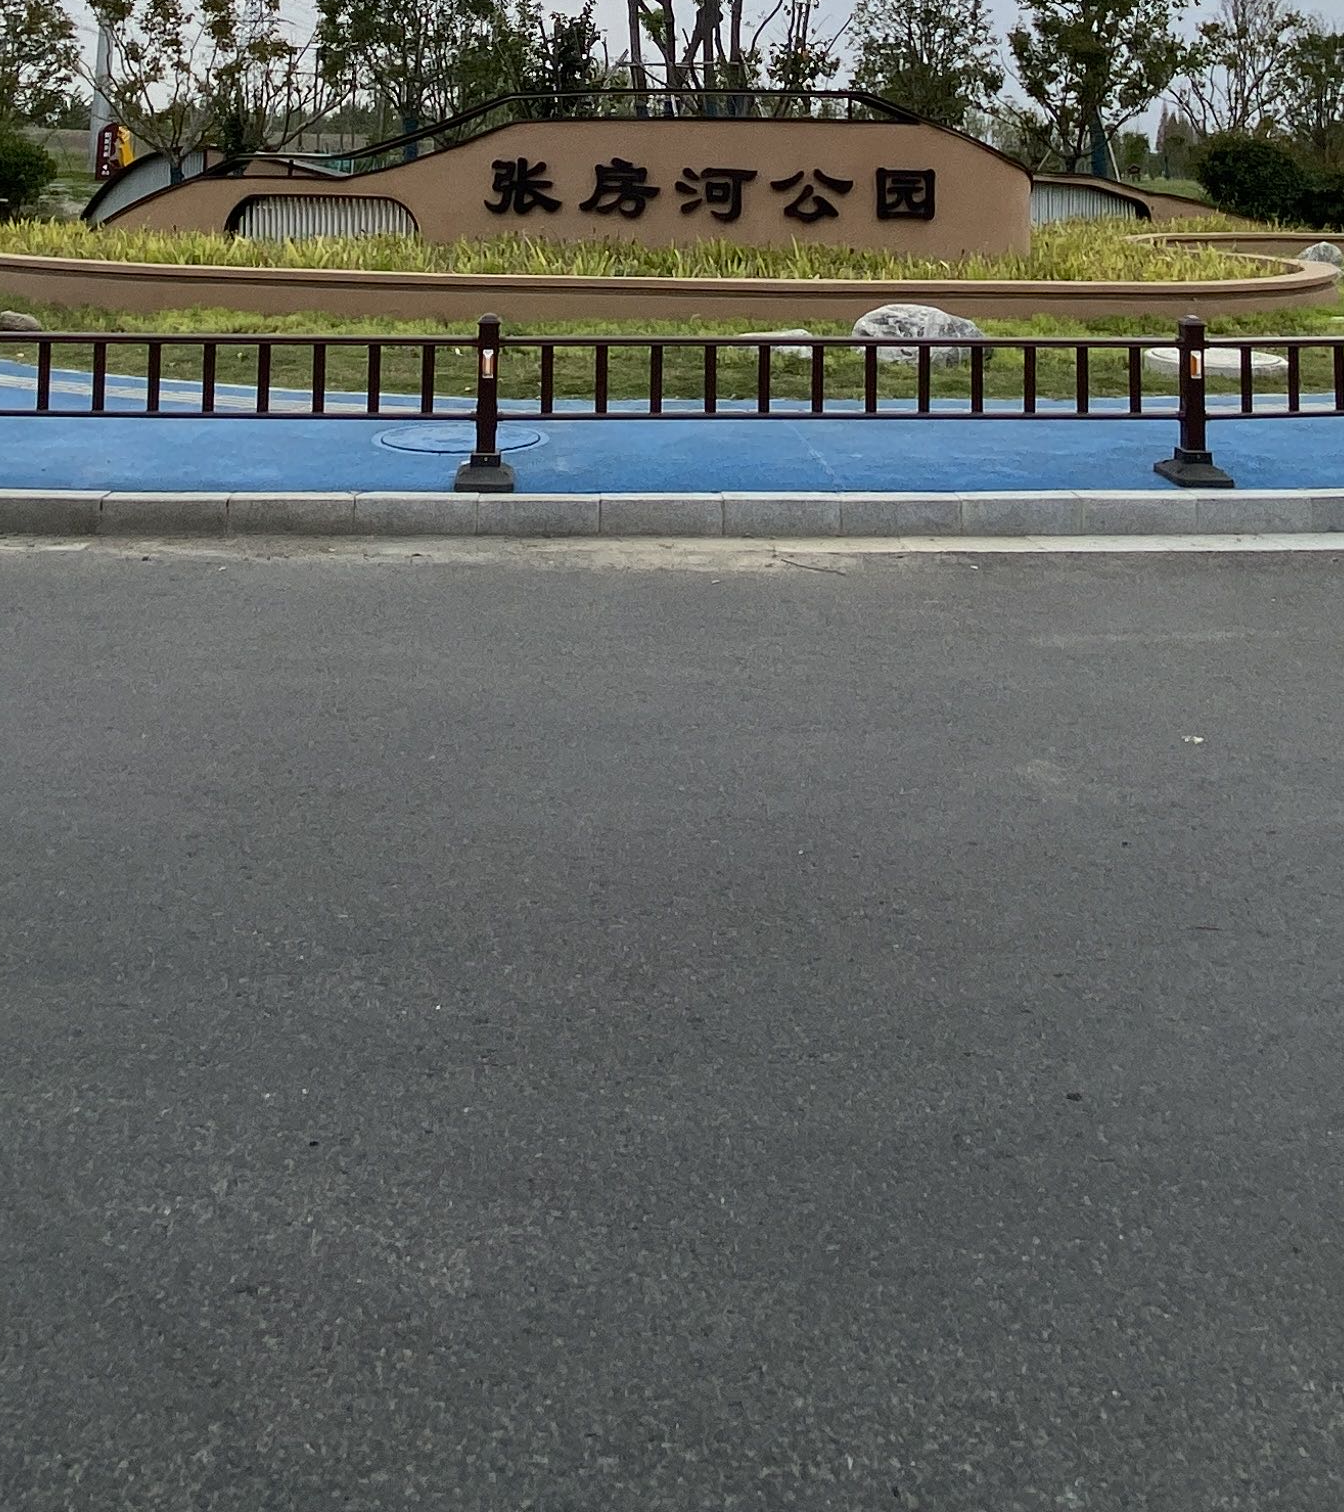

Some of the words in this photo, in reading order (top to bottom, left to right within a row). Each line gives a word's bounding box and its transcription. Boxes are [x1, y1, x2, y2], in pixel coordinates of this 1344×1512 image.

[483, 157, 936, 223] 张房河公园
